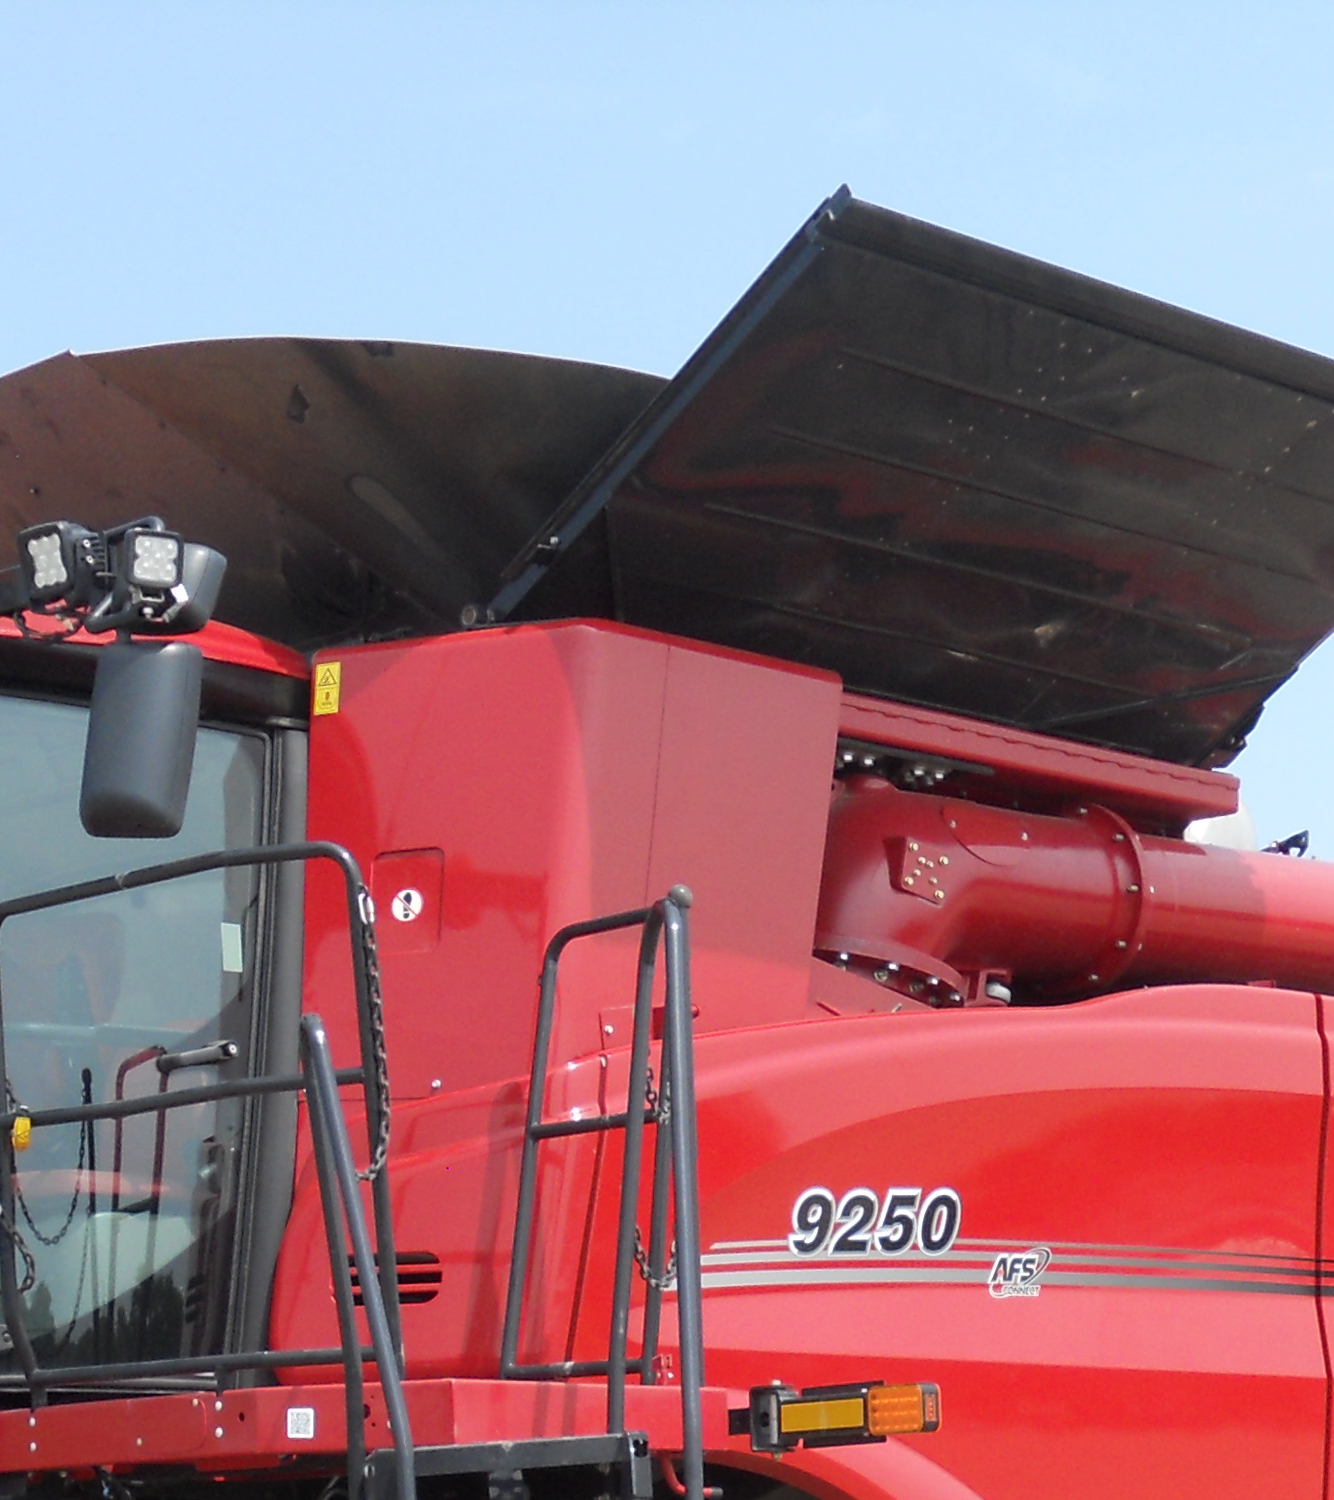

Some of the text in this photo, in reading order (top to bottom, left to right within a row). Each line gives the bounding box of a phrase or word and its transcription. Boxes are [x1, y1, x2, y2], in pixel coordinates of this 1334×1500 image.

[788, 1186, 963, 1257] 9250
[988, 1253, 1039, 1285] AFS
[1002, 1285, 1042, 1297] CONNECT
